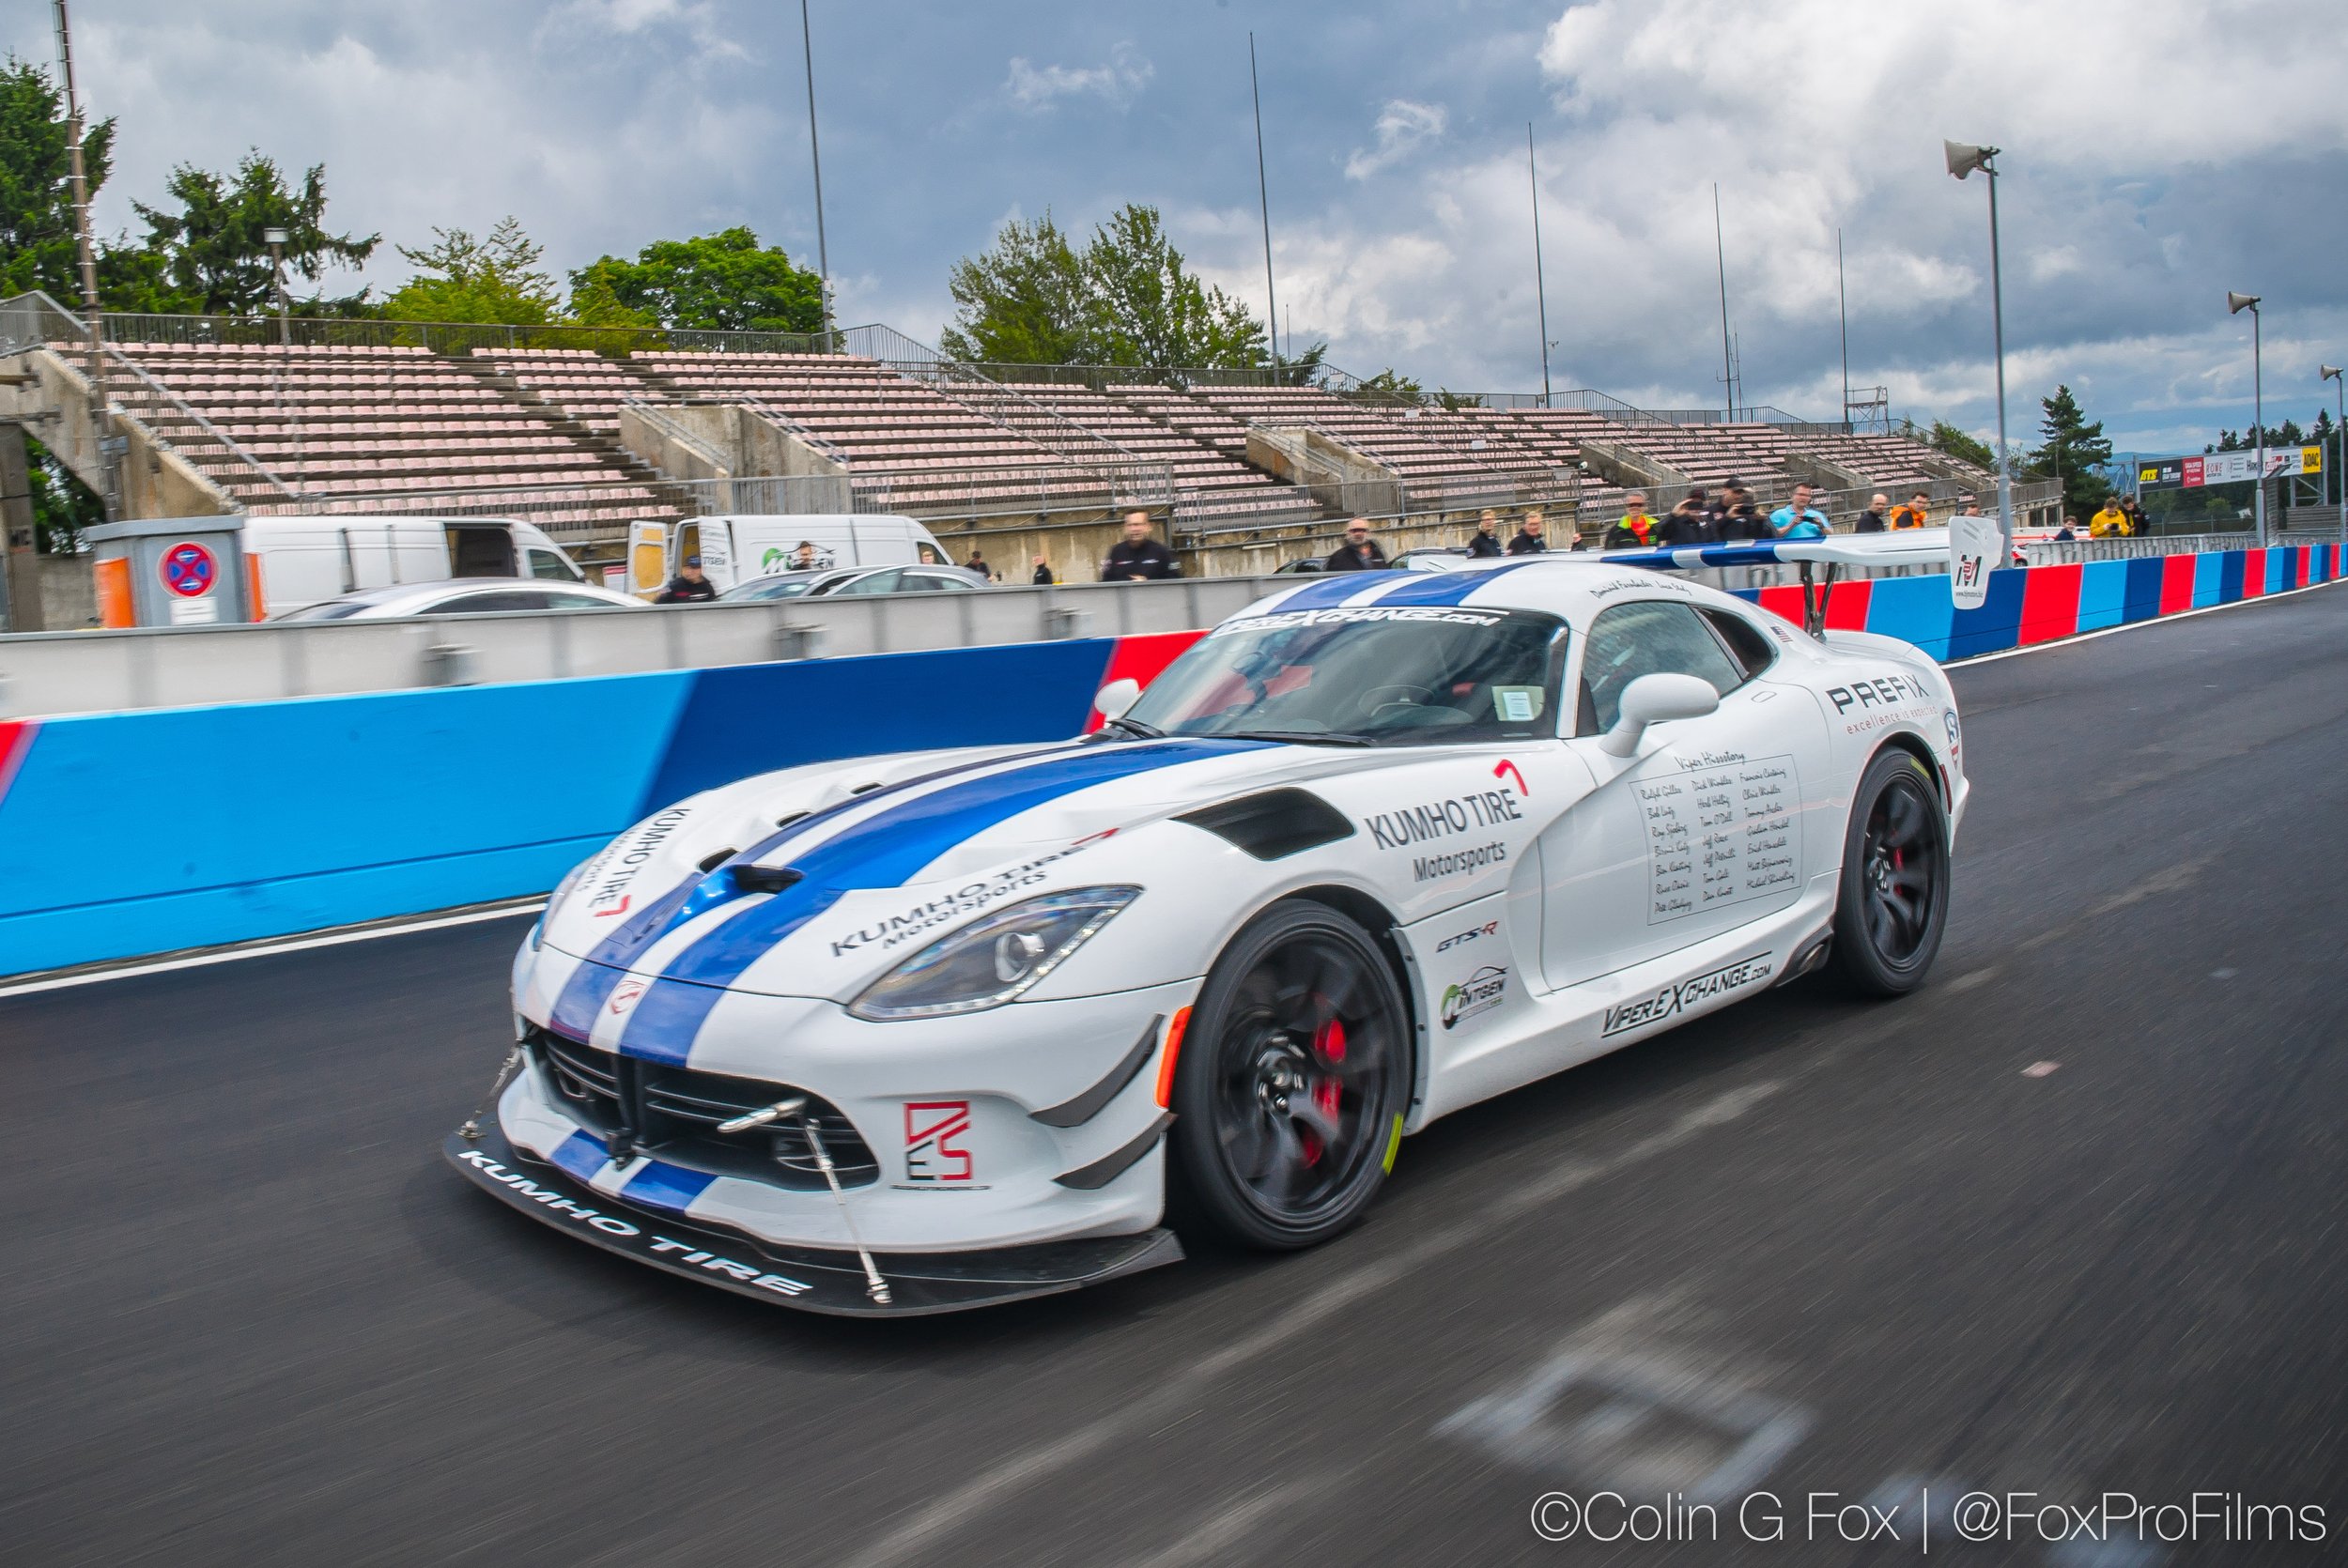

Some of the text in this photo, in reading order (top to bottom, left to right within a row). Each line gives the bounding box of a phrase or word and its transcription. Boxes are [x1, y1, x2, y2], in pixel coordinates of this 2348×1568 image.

[2206, 463, 2223, 473] ROWE
[2303, 453, 2320, 469] ADAC
[1825, 674, 1930, 715] PREFIX
[1846, 714, 1901, 734] excellence
[1902, 709, 1910, 719] is
[1674, 756, 1703, 772] Viper
[623, 808, 691, 864] KUMHO
[1364, 788, 1522, 850] KUMHO TIRE
[1413, 841, 1506, 882] Motorsports
[587, 866, 642, 908] TIRE
[830, 846, 1088, 957] KUMHO TIRE
[882, 870, 1047, 949] Motorsports
[456, 1150, 814, 1296] KUMHO TIRE
